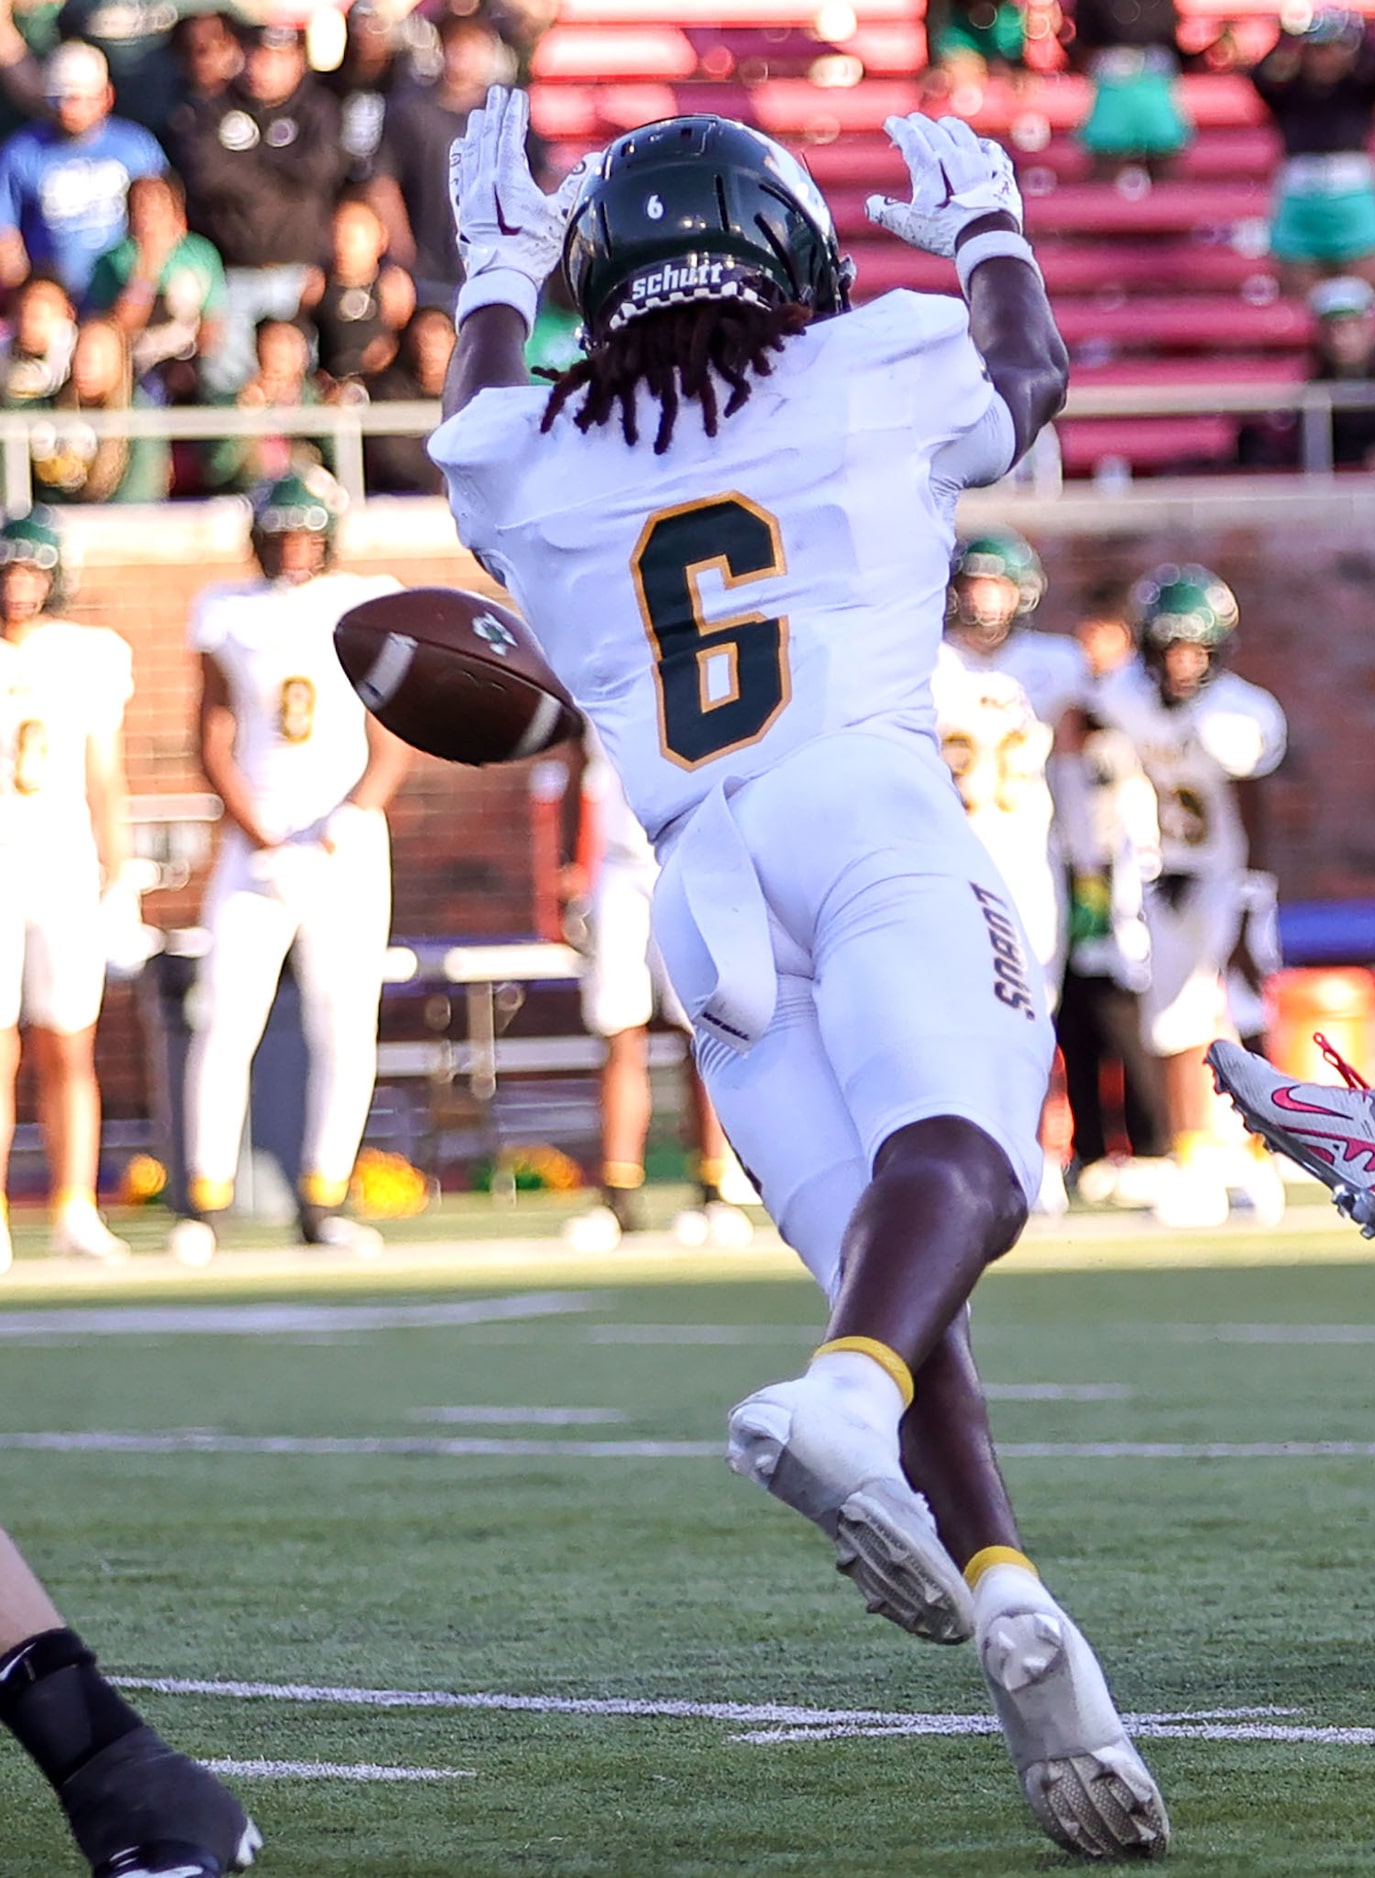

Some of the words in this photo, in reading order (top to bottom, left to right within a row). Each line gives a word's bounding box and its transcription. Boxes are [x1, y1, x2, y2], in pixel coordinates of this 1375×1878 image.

[646, 195, 664, 219] 6
[631, 261, 724, 300] schutt
[629, 489, 793, 774] 6
